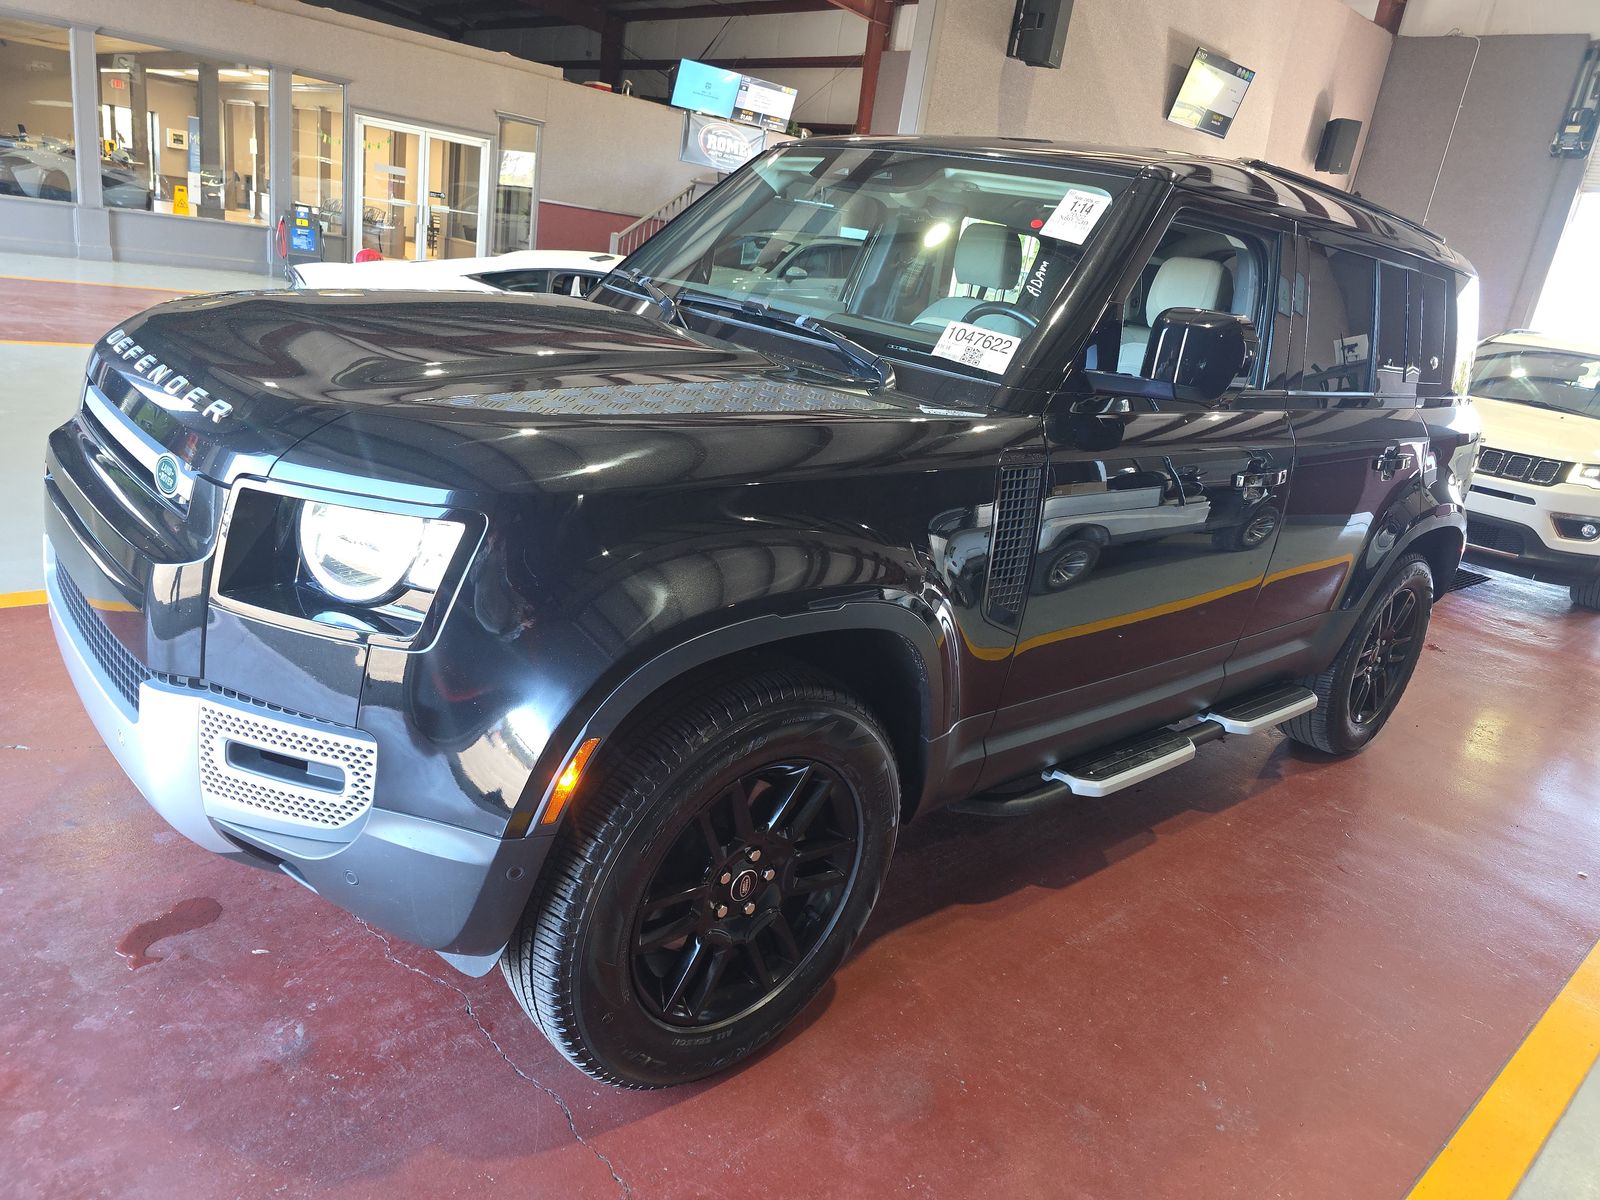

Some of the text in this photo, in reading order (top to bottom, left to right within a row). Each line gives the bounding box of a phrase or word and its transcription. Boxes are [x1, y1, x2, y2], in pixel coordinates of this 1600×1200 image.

[1069, 200, 1095, 215] 1:14
[948, 326, 1013, 355] 1047622
[106, 328, 233, 424] DEFENDER
[161, 462, 174, 476] LAND
